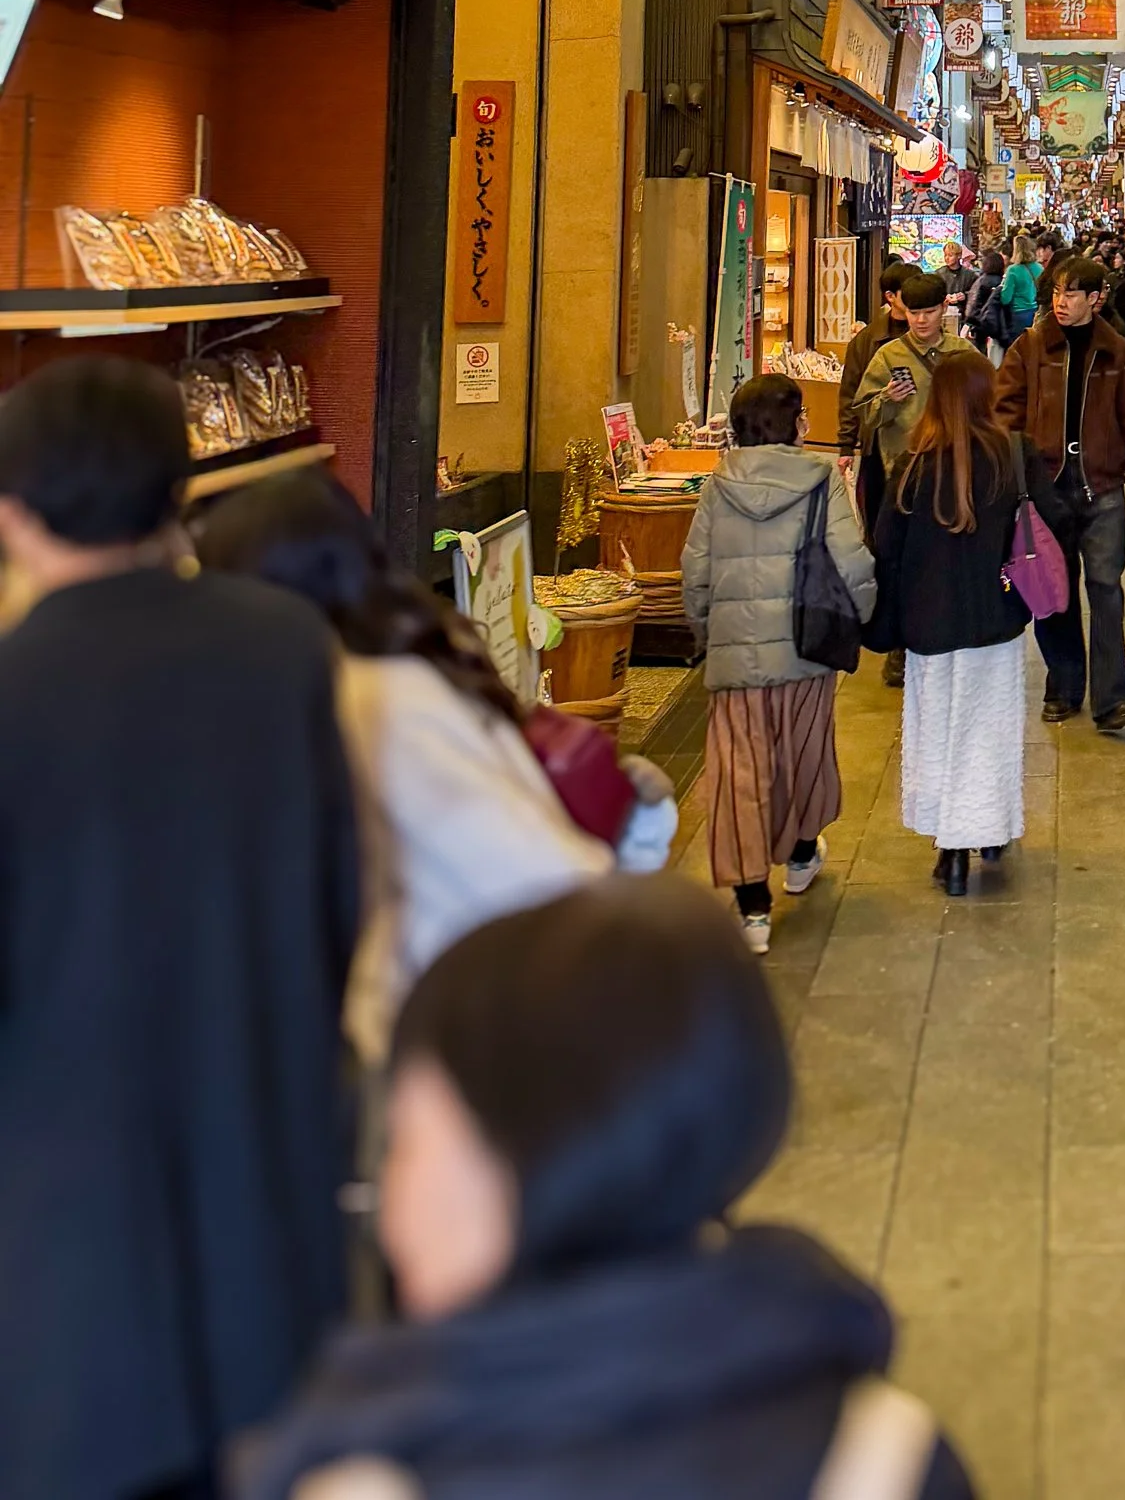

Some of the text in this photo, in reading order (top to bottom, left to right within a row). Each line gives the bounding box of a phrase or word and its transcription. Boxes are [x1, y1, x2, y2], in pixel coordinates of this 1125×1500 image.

[951, 23, 975, 51] 錦
[477, 101, 496, 119] 旬
[472, 127, 495, 308] おいしく、やさしく。
